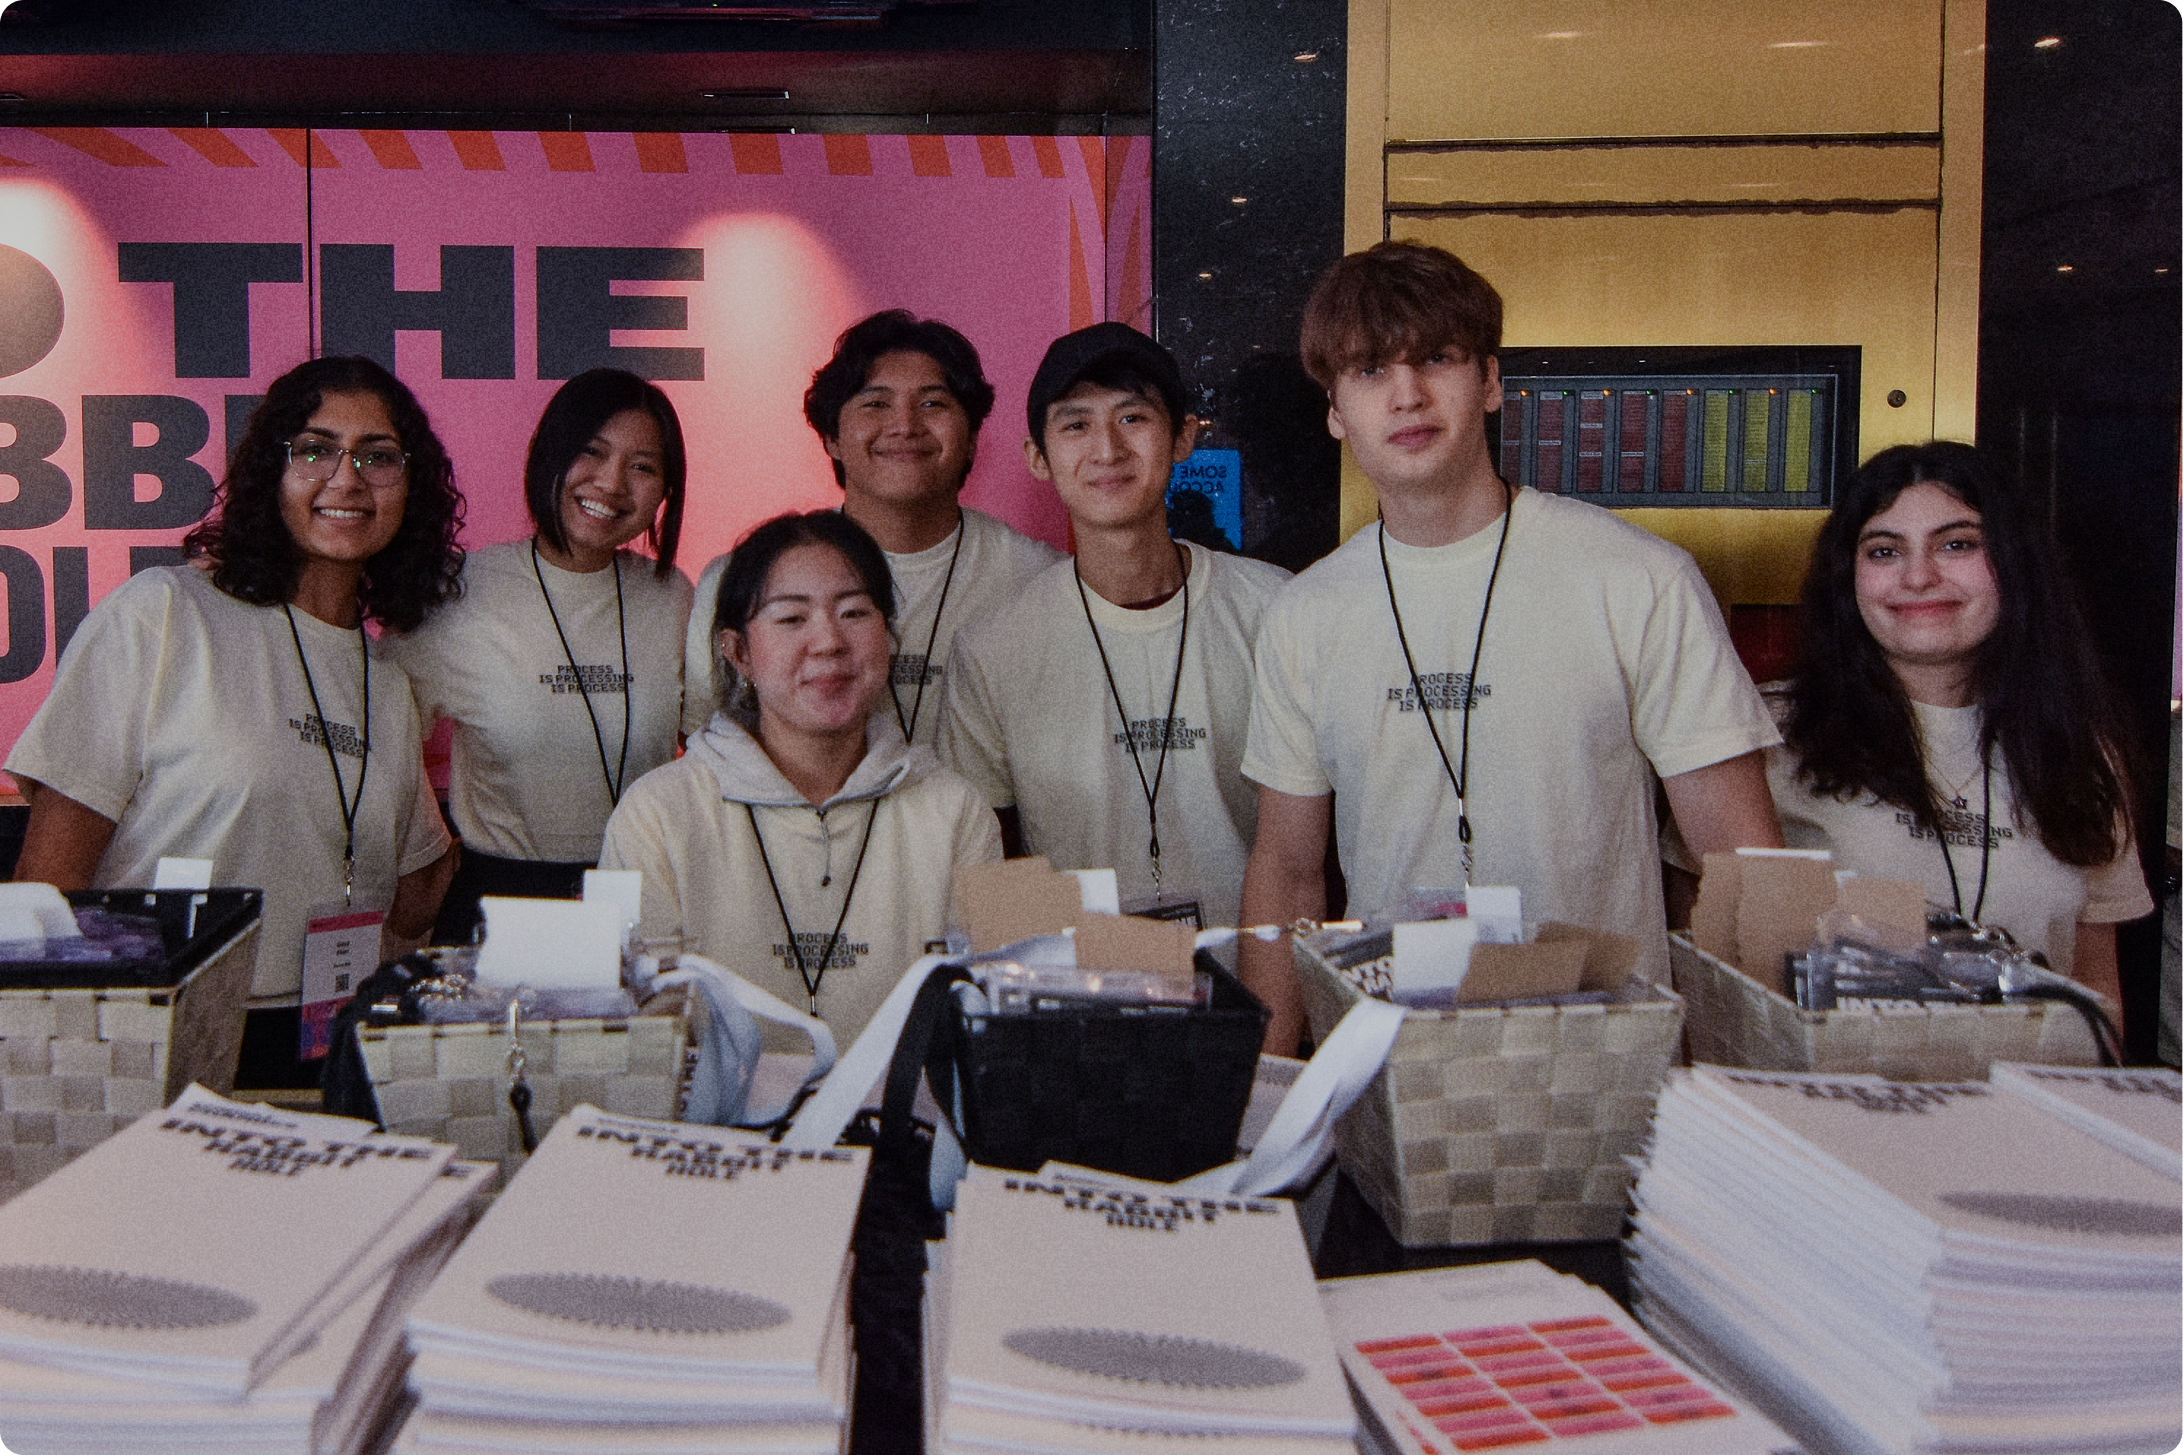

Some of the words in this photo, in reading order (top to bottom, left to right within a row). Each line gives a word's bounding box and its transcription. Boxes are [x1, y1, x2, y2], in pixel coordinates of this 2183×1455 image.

[118, 242, 705, 381] THE
[540, 675, 553, 684] IS
[1410, 673, 1473, 686] ROCESS
[551, 684, 565, 693] IS
[1387, 688, 1403, 701] IS
[1405, 684, 1491, 698] POCESSNG
[1399, 700, 1414, 712] IS
[306, 713, 356, 736] PRCESS
[575, 1125, 724, 1151] INTO
[1003, 1178, 1150, 1203] INTO
